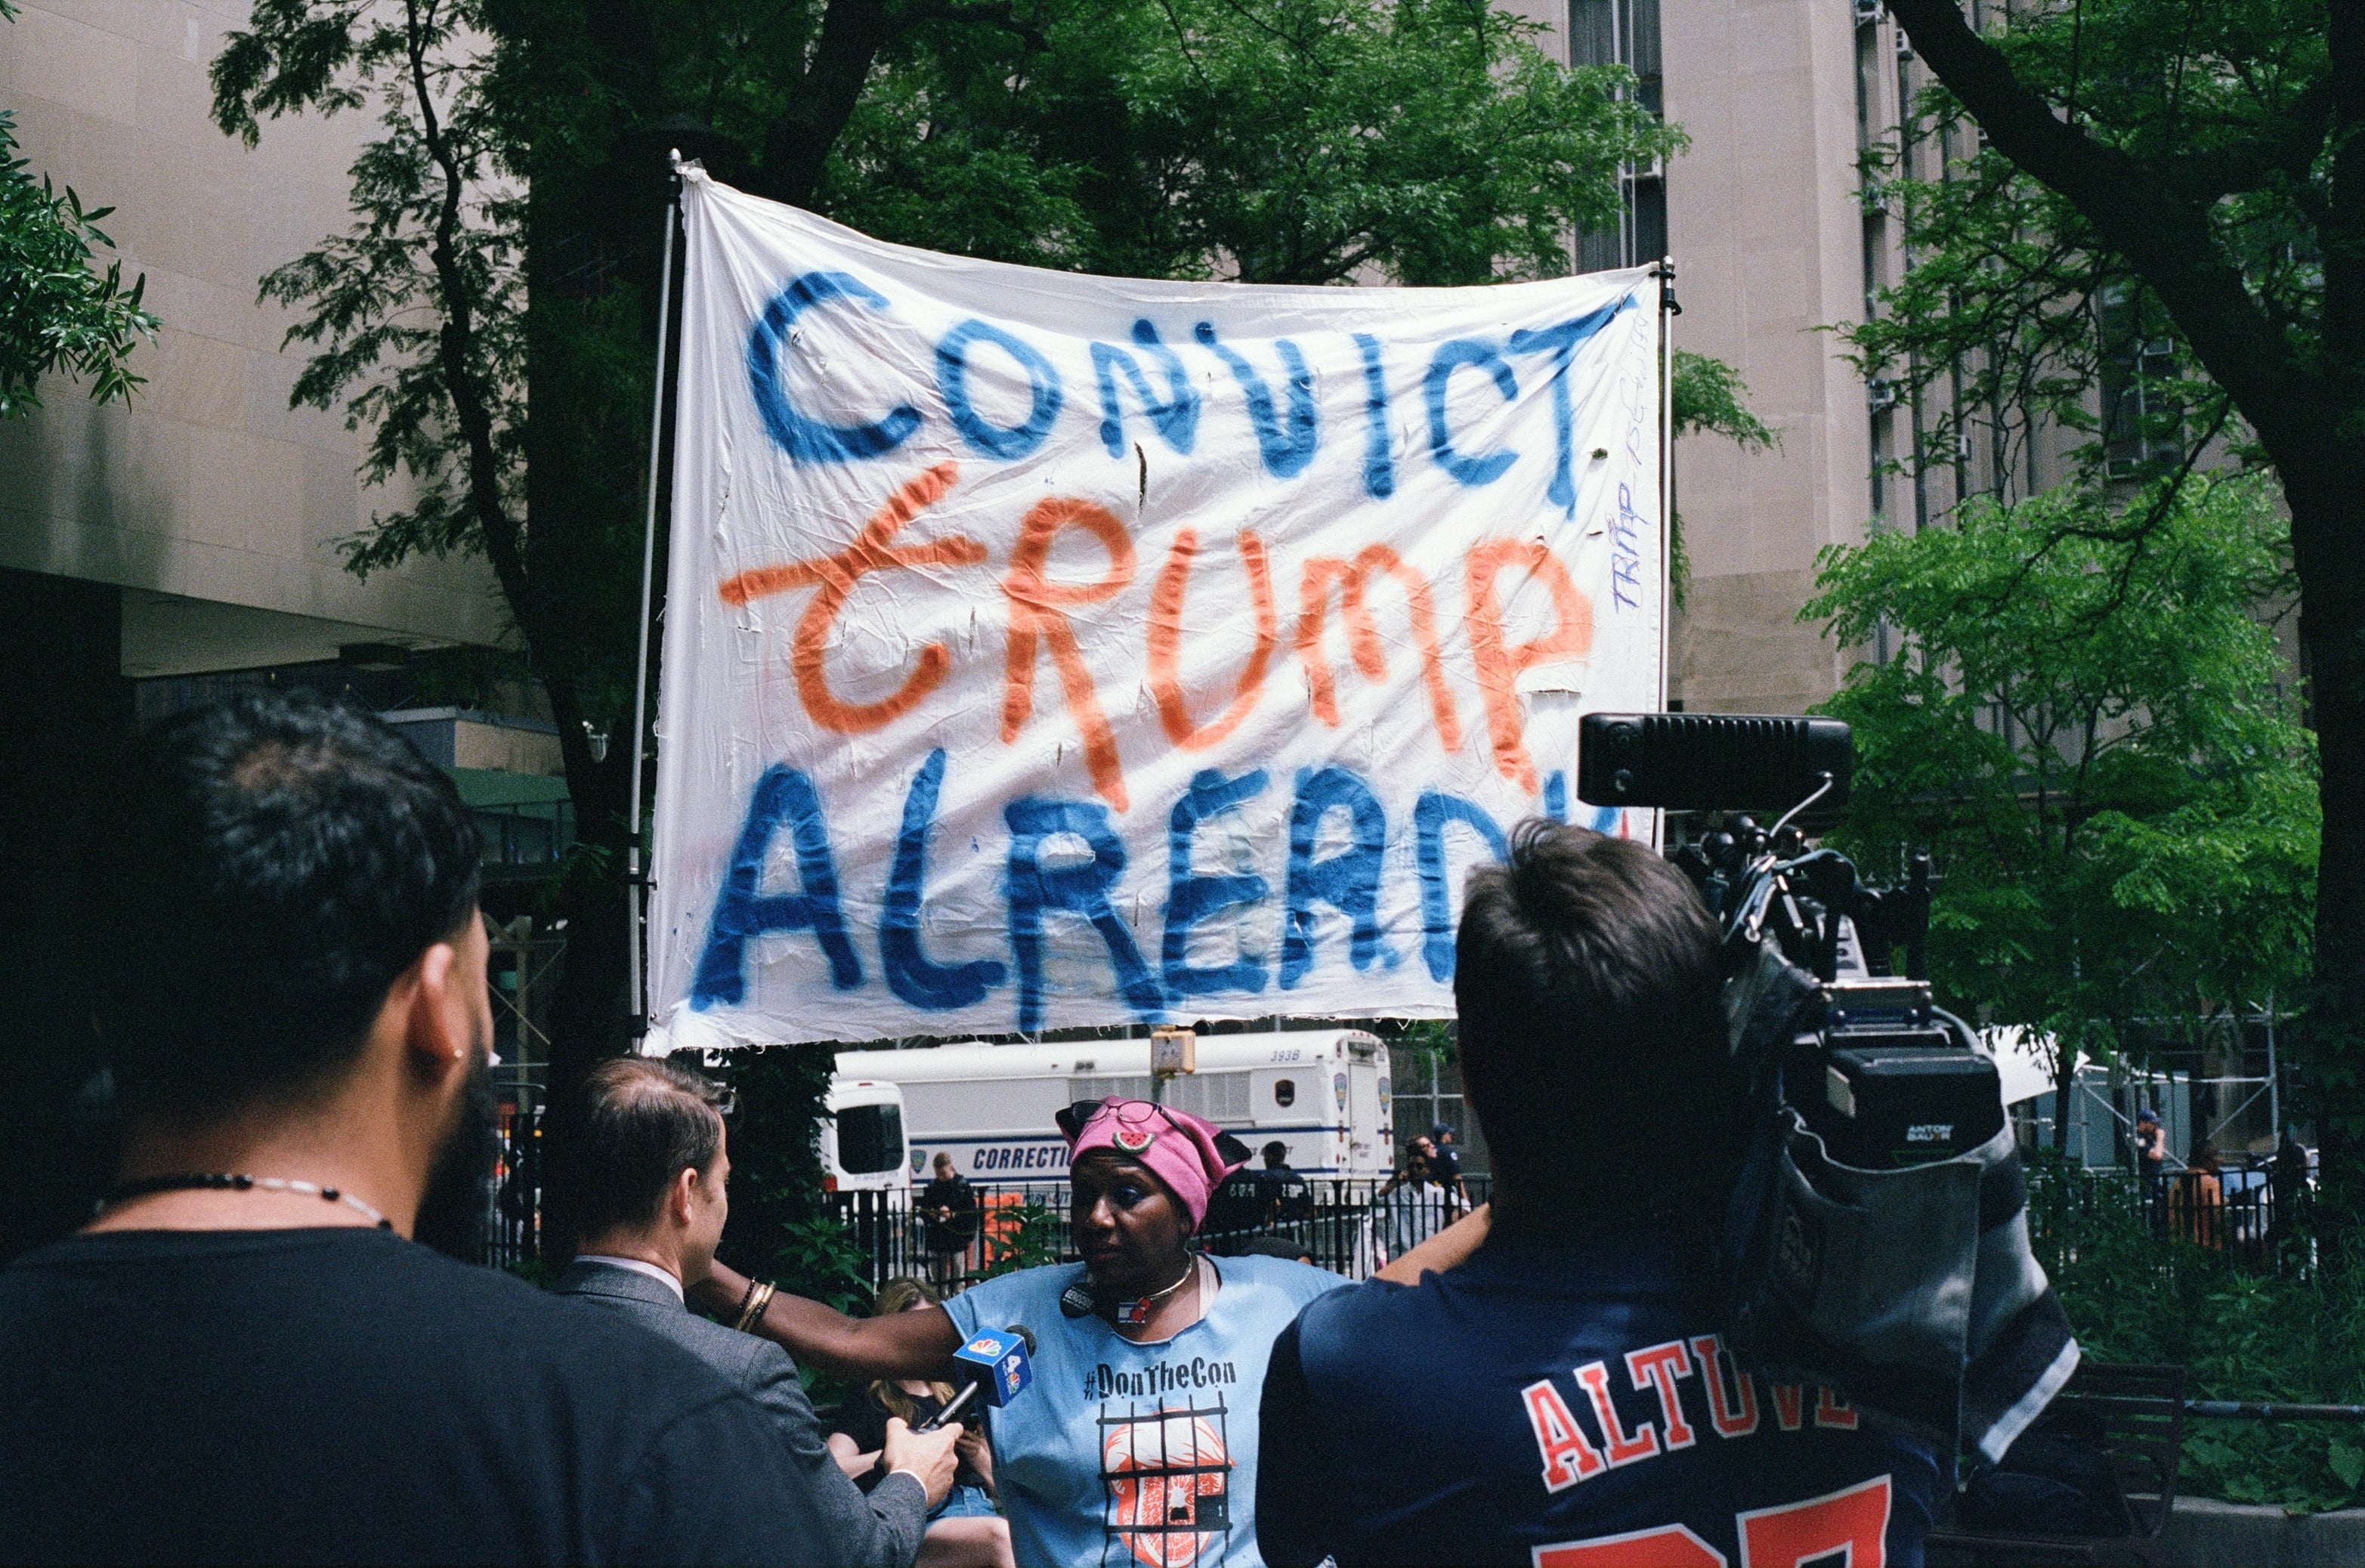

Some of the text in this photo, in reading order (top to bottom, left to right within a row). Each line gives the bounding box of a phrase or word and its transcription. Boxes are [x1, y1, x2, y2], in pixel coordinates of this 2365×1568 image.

[748, 269, 1635, 521] CONVICT
[718, 459, 1594, 812] TRUMP
[688, 746, 1619, 1033] ALREAD
